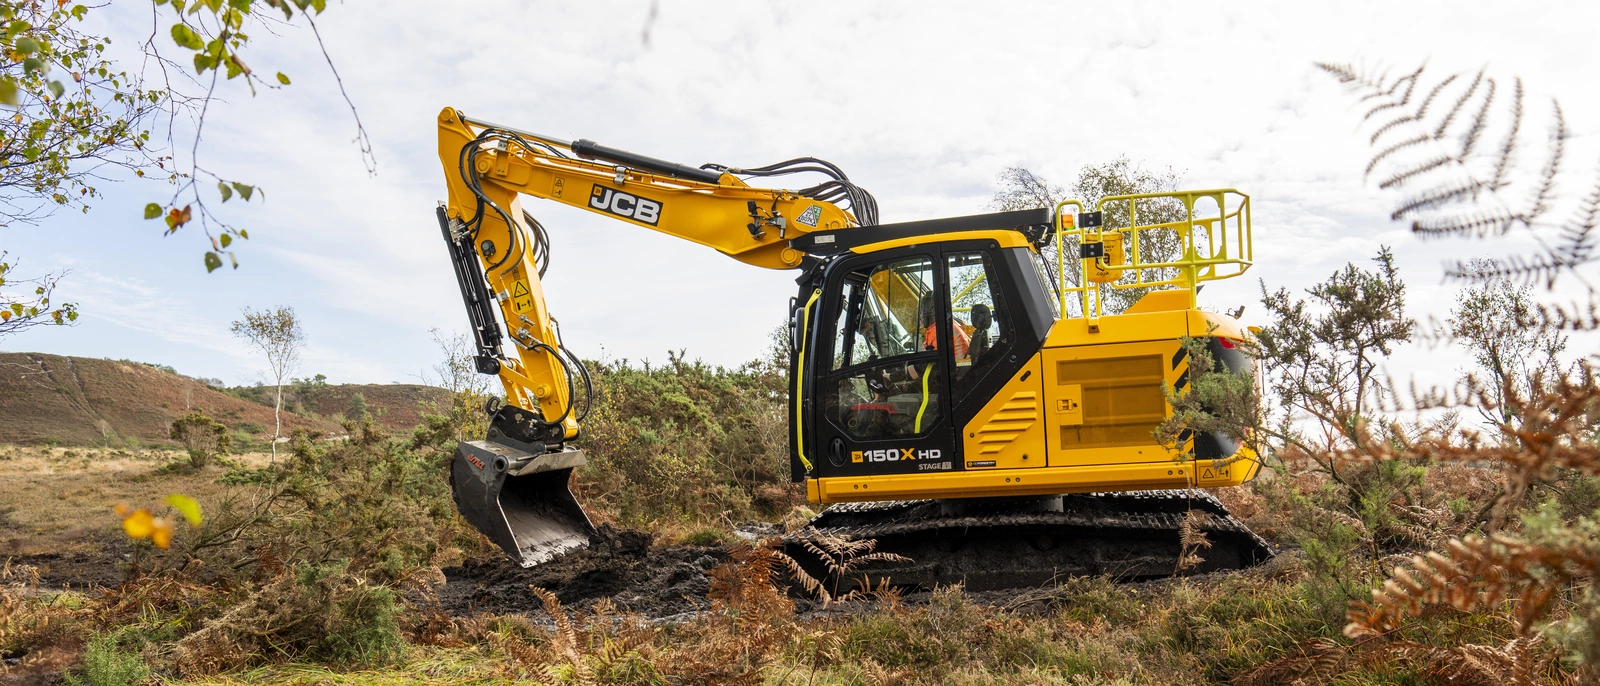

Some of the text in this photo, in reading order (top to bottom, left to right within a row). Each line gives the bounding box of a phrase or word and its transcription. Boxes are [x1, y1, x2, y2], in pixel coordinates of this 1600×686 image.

[591, 189, 660, 224] JCB
[918, 449, 941, 460] HD
[918, 462, 941, 470] STAGE
